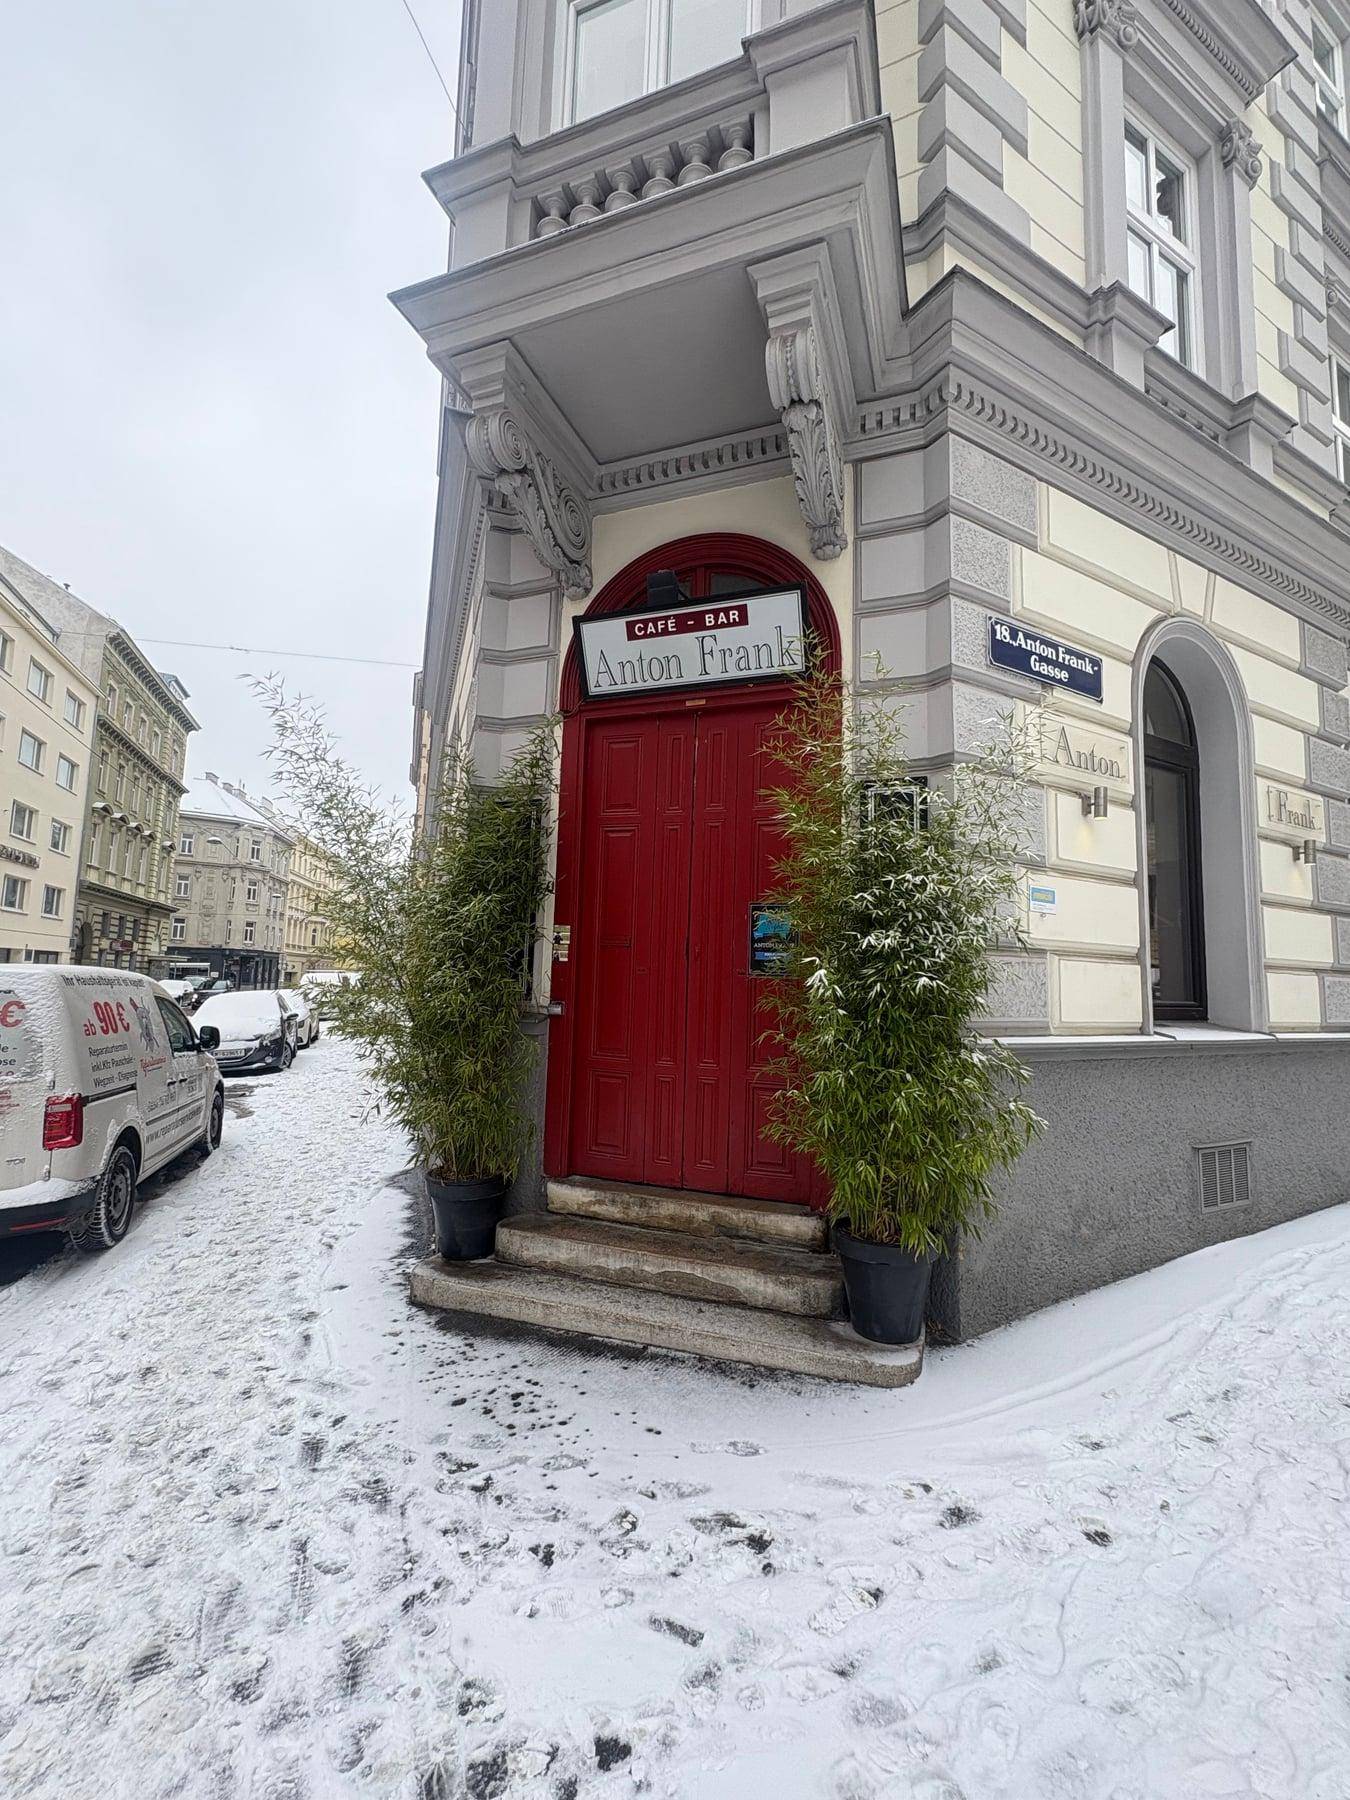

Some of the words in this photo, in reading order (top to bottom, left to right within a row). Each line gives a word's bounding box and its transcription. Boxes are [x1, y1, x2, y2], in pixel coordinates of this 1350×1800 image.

[634, 616, 677, 637] CAFÉ
[704, 609, 741, 628] BAR
[593, 648, 685, 688] Anton
[694, 626, 798, 677] Frank
[1014, 631, 1057, 661] Anton
[1057, 646, 1099, 675] Frank-
[1029, 654, 1070, 682] Gasse
[1055, 725, 1121, 779] Anton
[1275, 789, 1316, 831] Frank
[83, 1018, 97, 1037] ab
